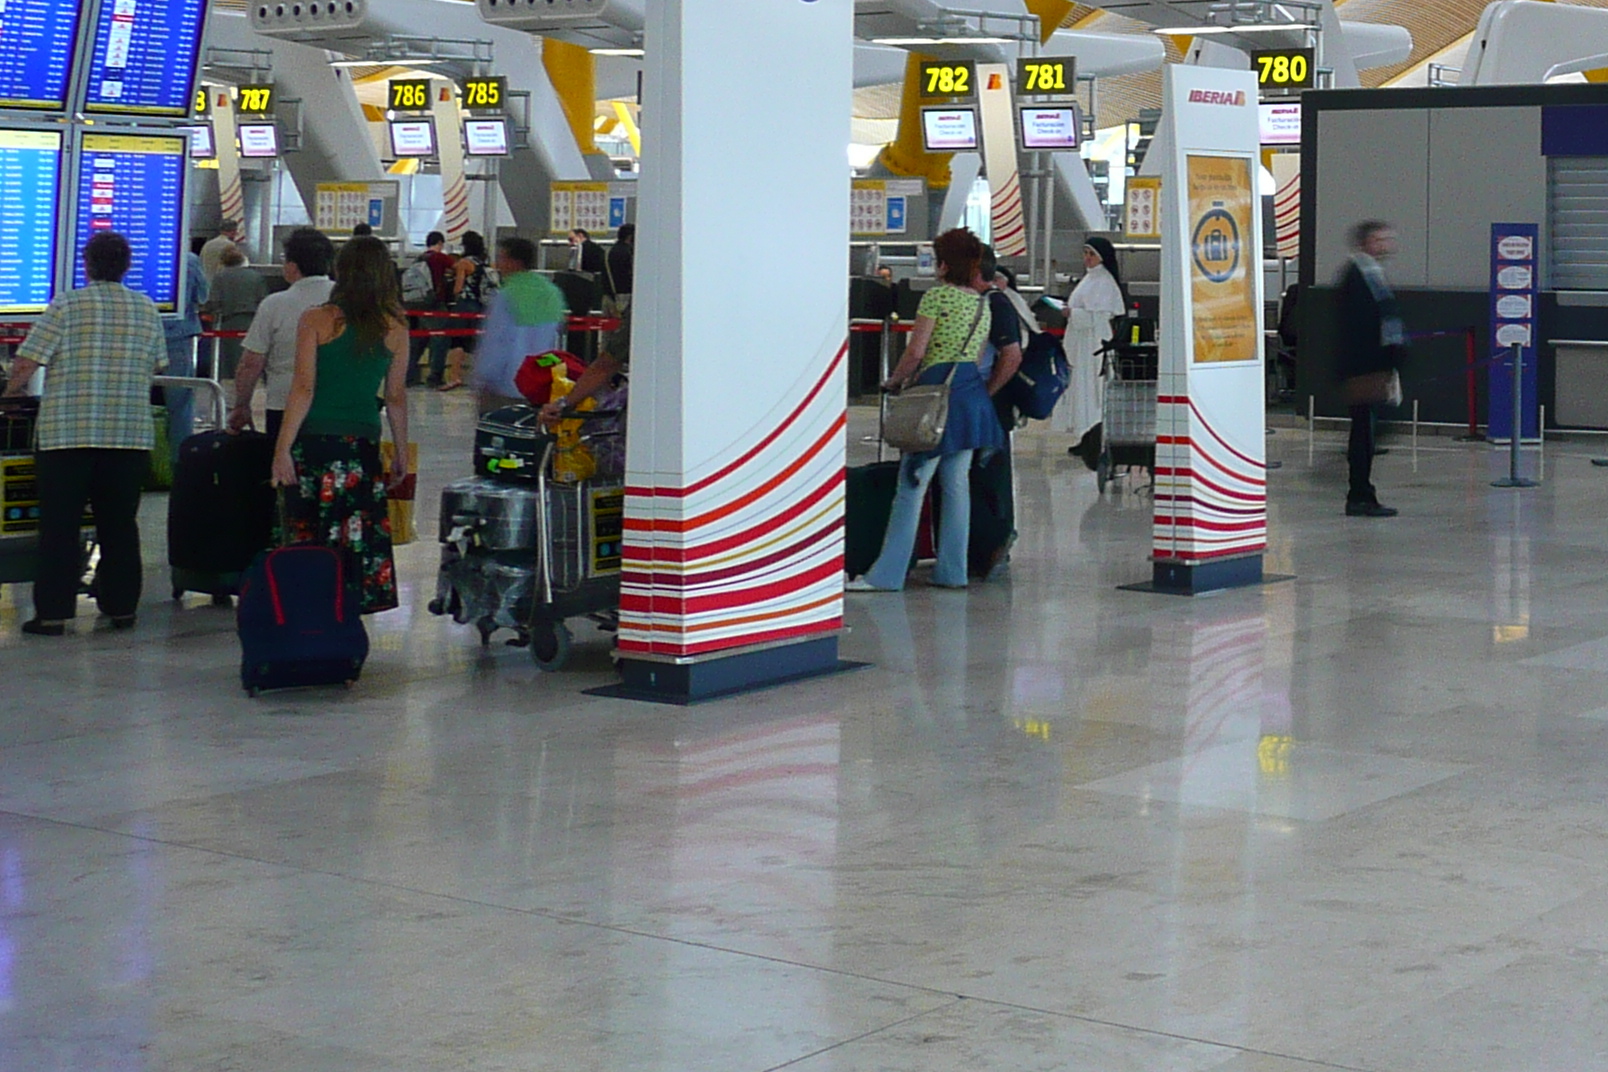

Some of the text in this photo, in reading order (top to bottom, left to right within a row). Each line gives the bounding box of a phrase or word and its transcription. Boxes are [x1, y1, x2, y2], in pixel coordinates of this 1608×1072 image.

[925, 66, 970, 93] 782
[1024, 63, 1066, 90] 781
[1257, 55, 1308, 84] 780
[240, 89, 271, 111] 787
[392, 84, 426, 107] 786
[465, 82, 500, 106] 785
[1188, 89, 1235, 105] IBERIA
